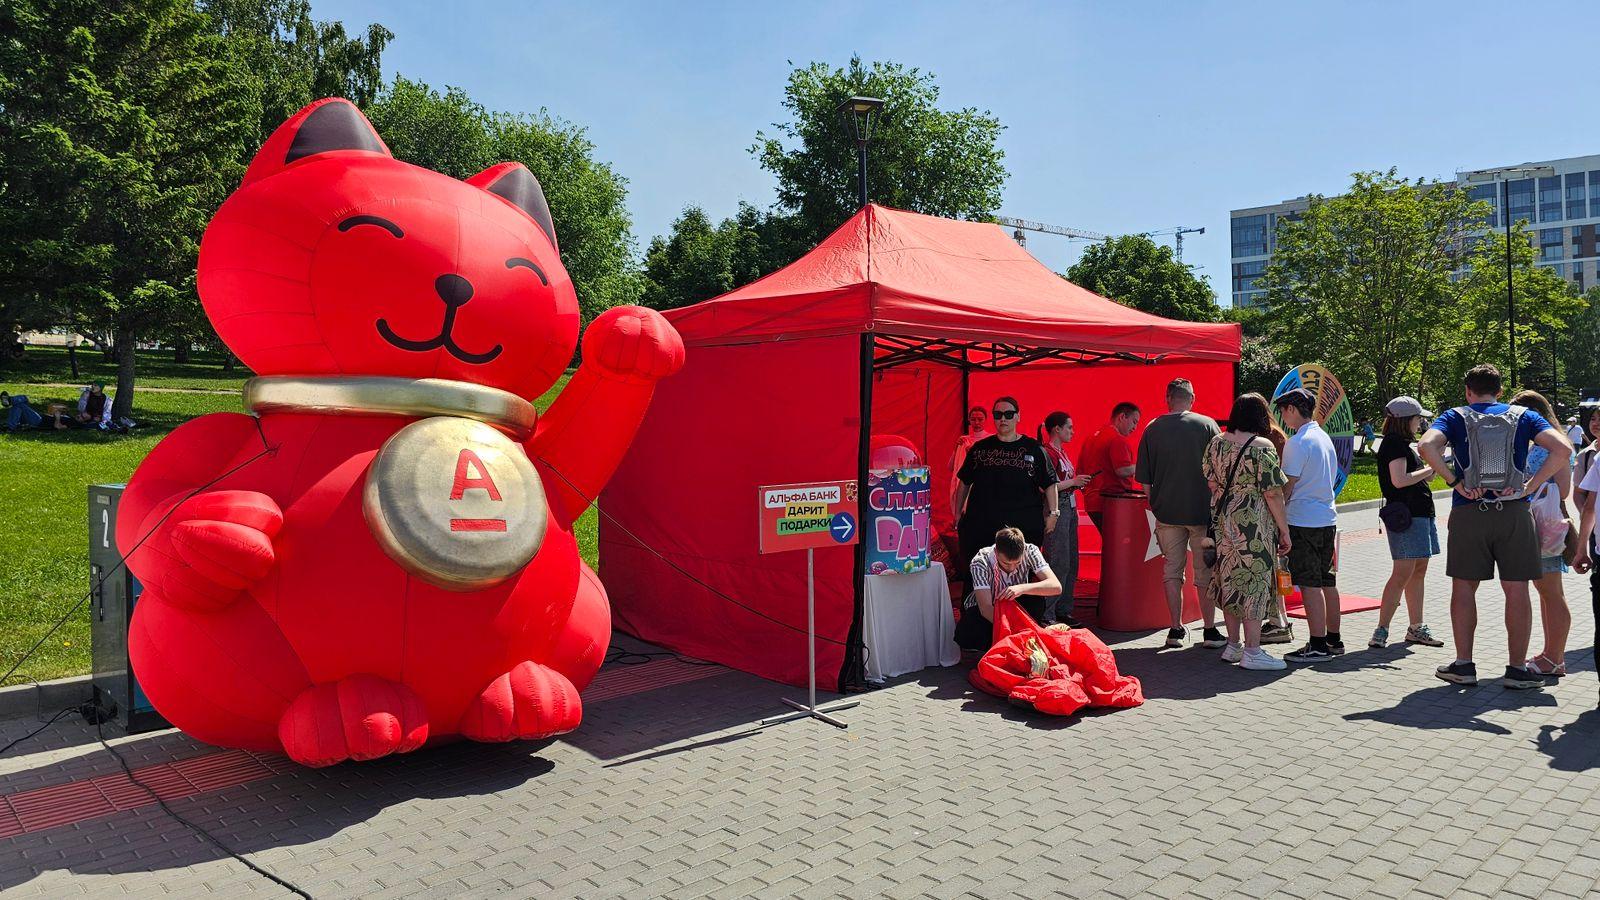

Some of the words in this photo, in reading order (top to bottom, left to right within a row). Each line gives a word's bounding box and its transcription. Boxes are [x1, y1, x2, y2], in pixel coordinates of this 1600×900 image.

[768, 492, 808, 504] АЛЬФА
[809, 490, 838, 502] БАНК
[787, 506, 825, 517] ДАРИТ
[780, 517, 833, 532] ПОДАРКИ
